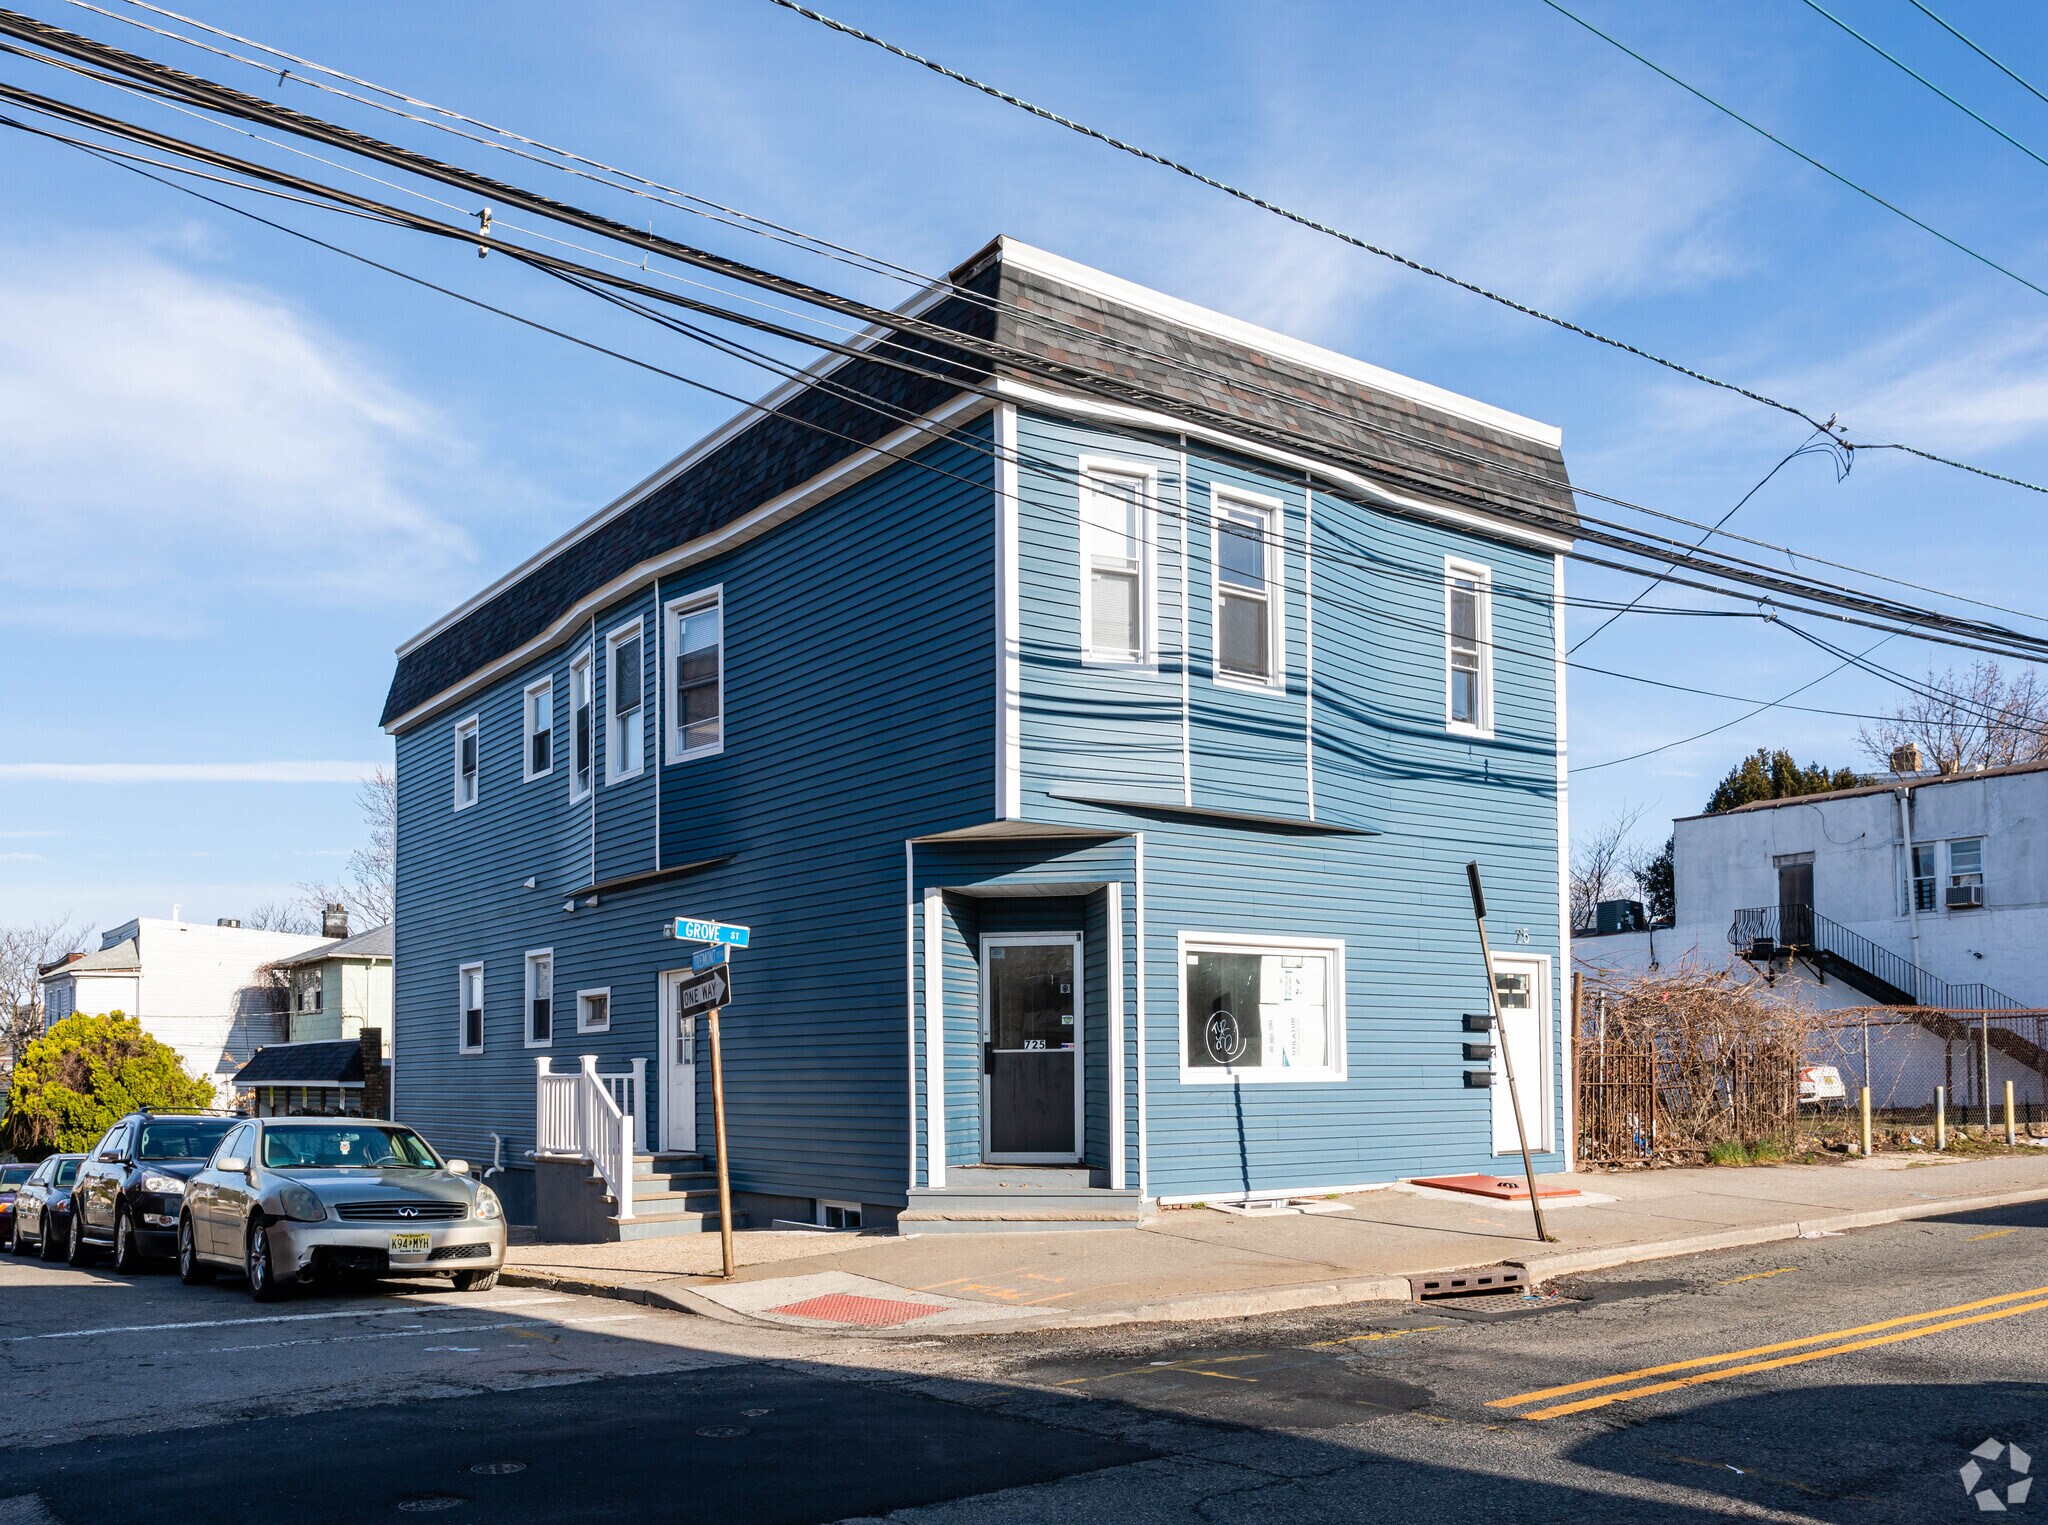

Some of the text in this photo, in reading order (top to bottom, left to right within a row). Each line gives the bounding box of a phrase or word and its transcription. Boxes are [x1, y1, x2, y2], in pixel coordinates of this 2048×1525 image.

[686, 922, 740, 941] GROVE ST
[693, 949, 716, 969] TREMONT
[684, 981, 717, 1006] ONE WAY
[1025, 1040, 1045, 1050] 725
